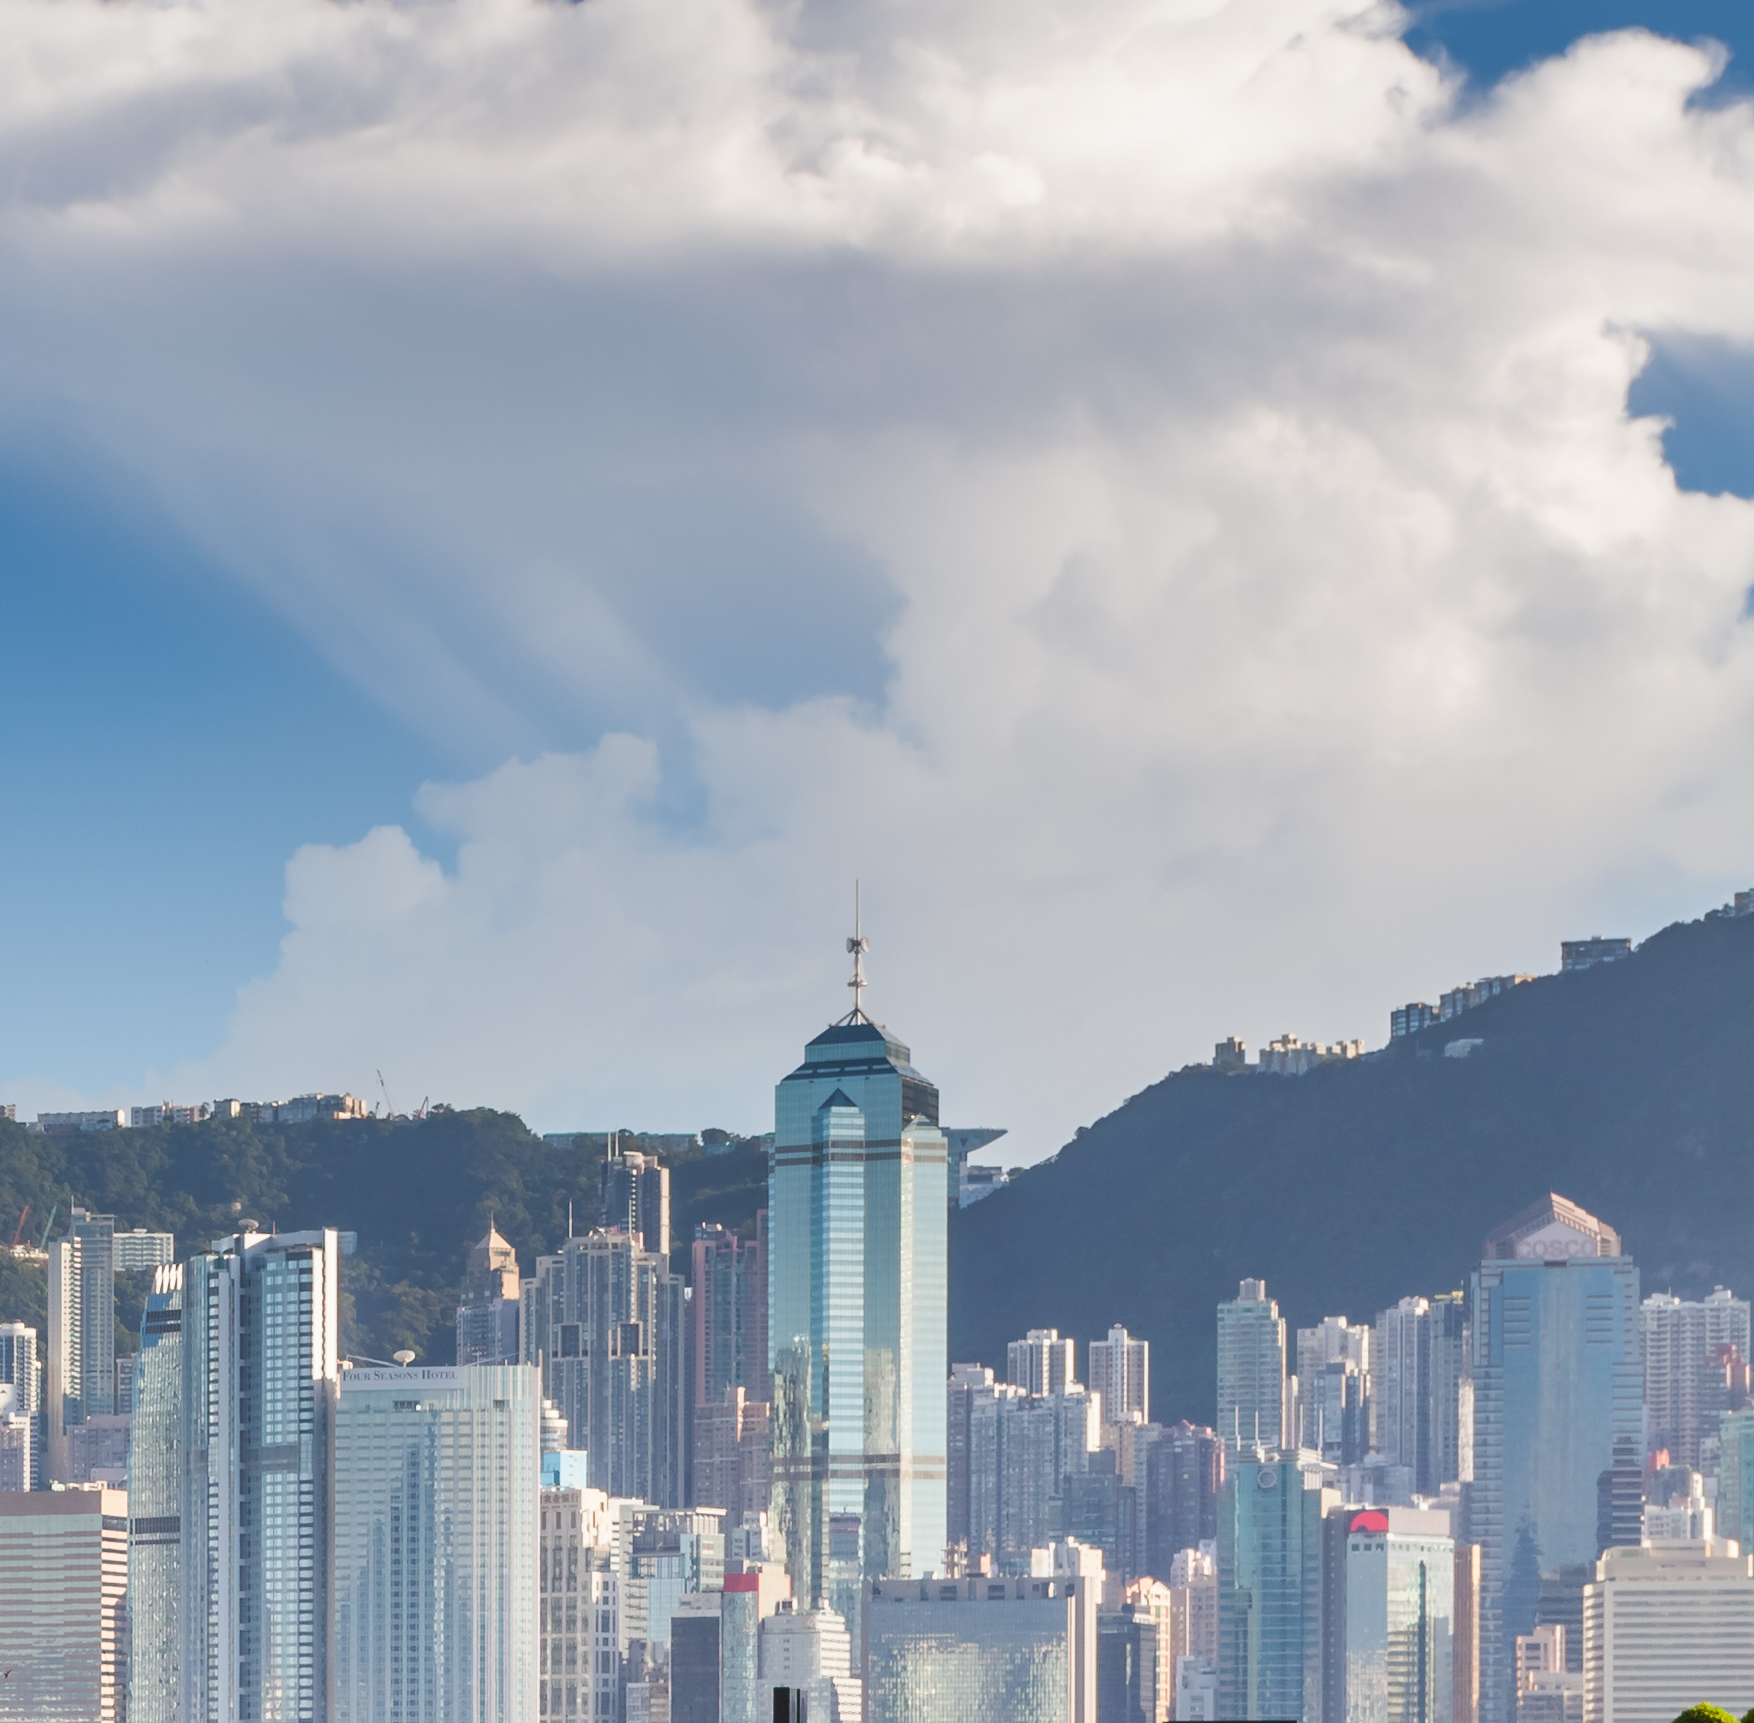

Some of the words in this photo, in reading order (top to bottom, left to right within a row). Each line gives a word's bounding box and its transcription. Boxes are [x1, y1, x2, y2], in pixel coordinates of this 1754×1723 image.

[1517, 1239, 1595, 1257] COSCO
[342, 1371, 371, 1381] FOUR
[373, 1370, 418, 1380] SEASONS
[421, 1369, 458, 1380] HOTEL
